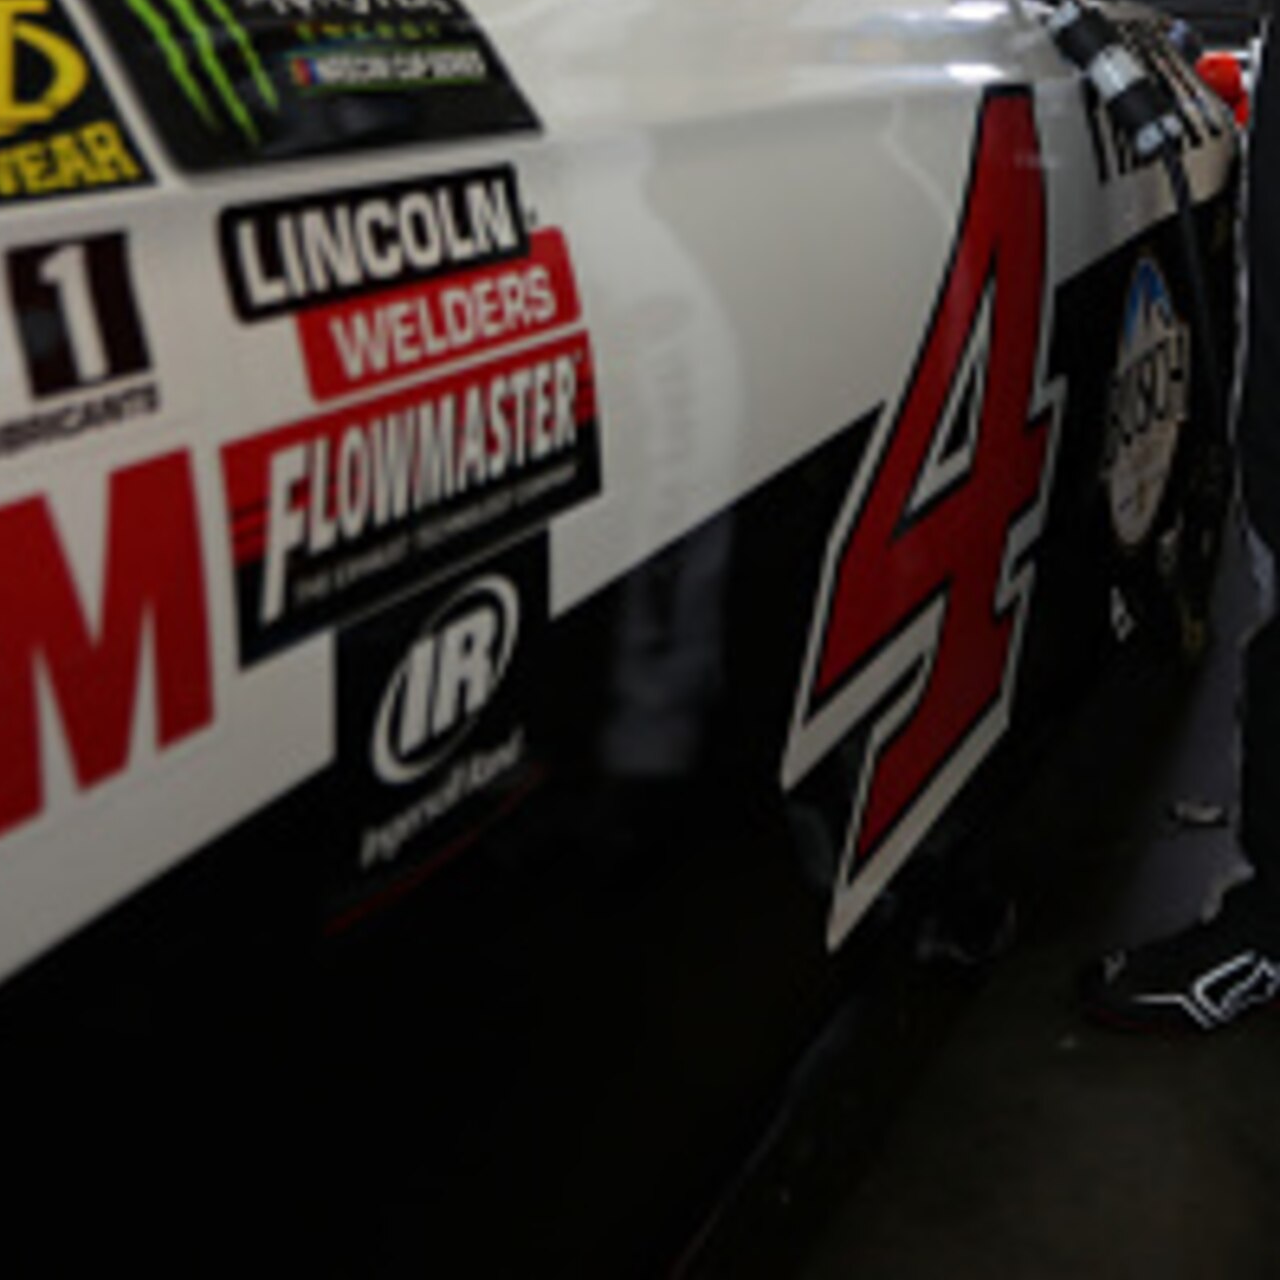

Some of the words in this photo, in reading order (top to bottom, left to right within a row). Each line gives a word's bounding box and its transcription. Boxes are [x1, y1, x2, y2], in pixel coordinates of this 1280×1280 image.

[36, 241, 120, 385] 1
[235, 177, 519, 309] LINCOLN
[329, 266, 559, 382] WELDERS
[259, 353, 580, 627] FLOWMASTER
[781, 84, 1066, 953] 4
[398, 605, 497, 758] IR
